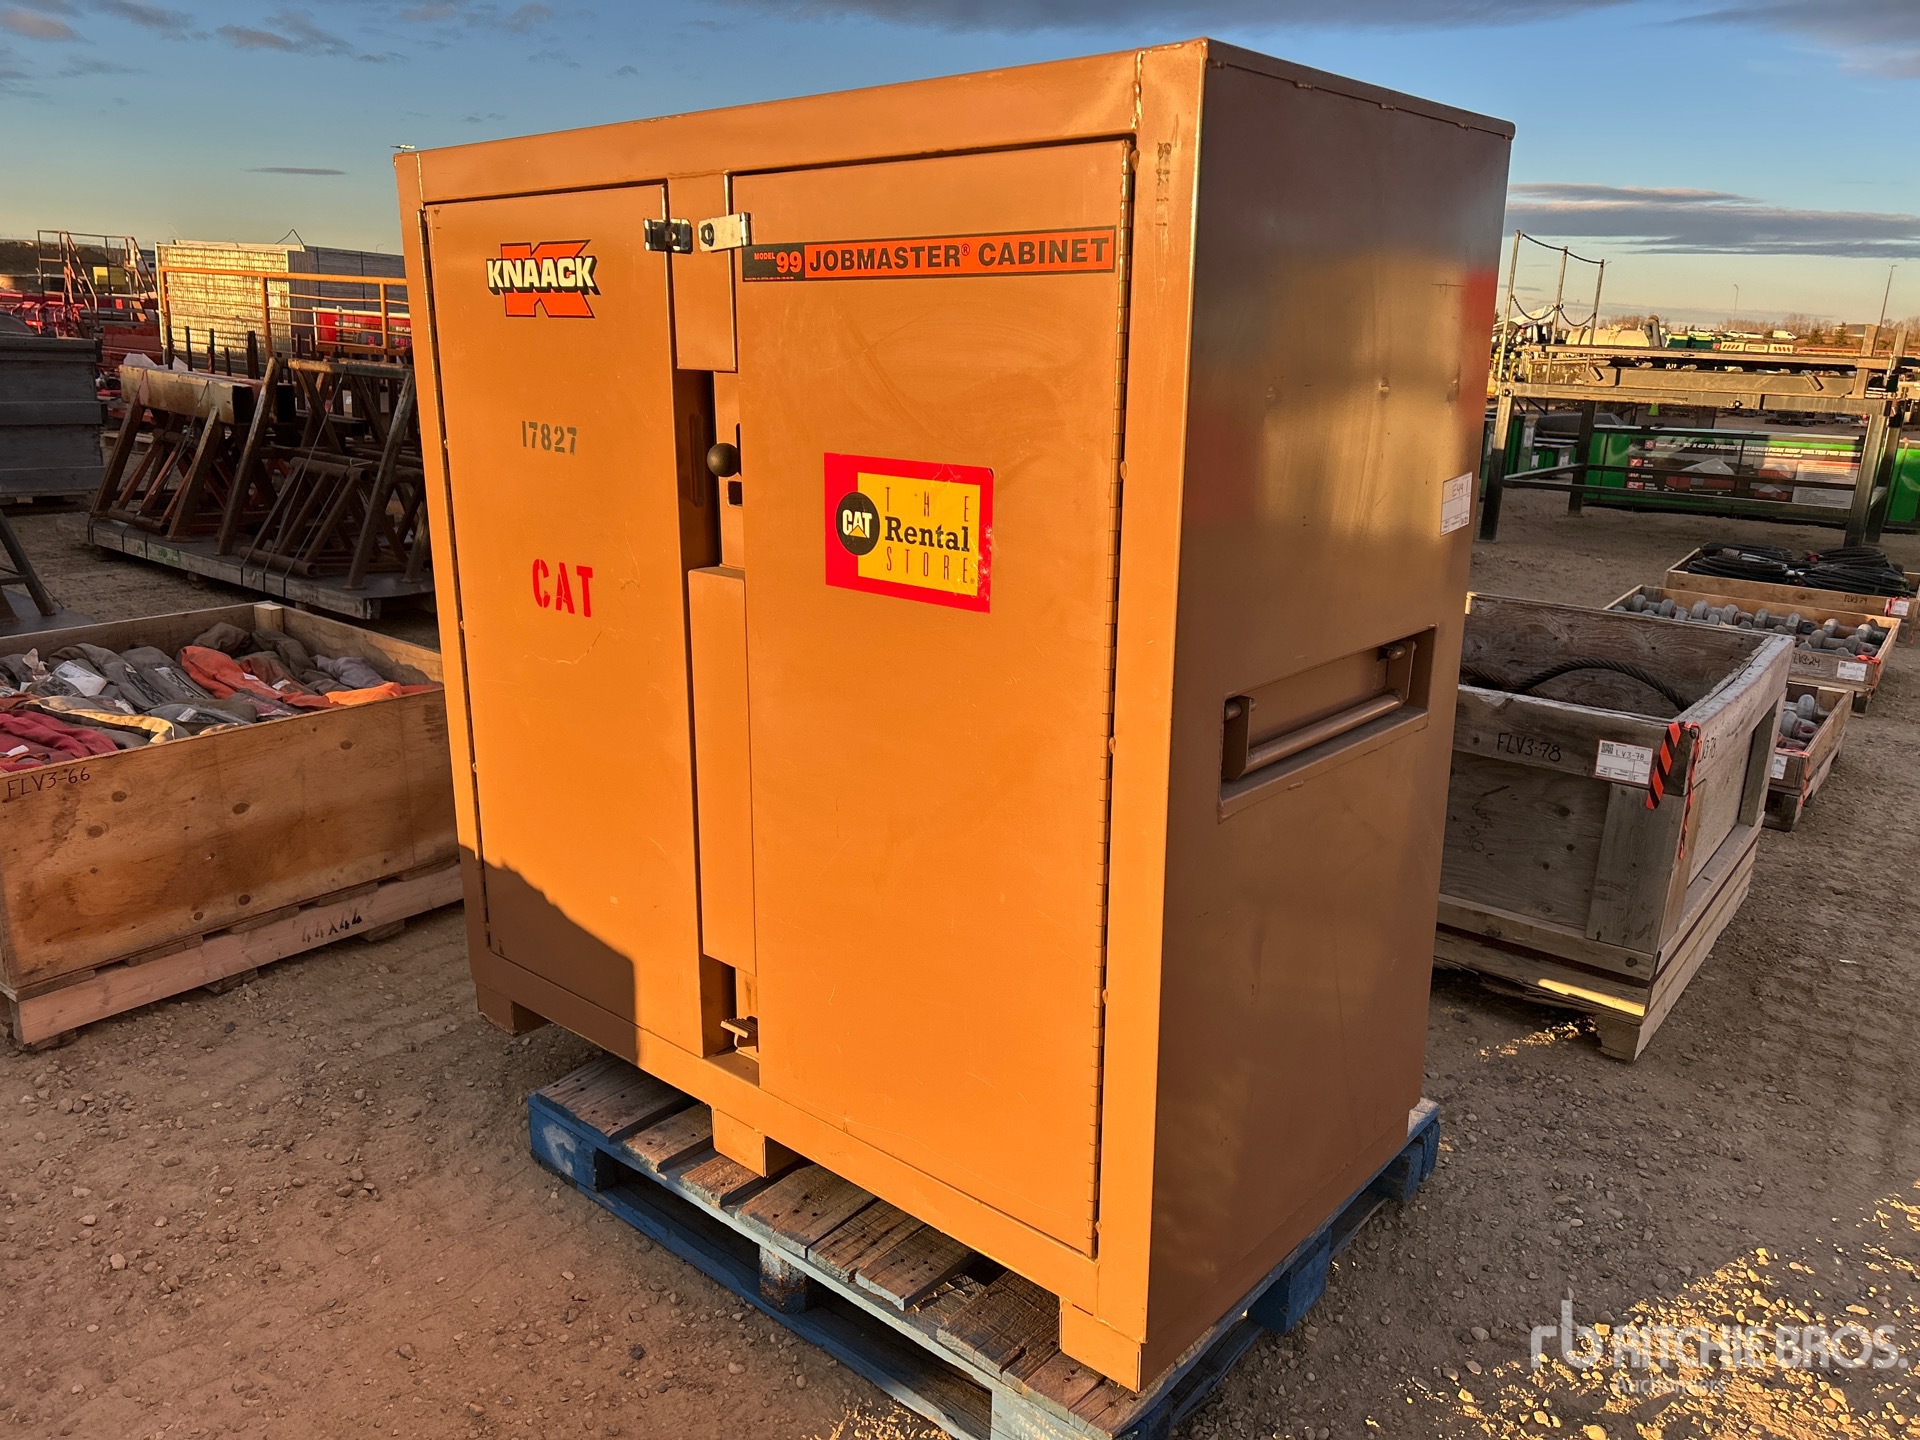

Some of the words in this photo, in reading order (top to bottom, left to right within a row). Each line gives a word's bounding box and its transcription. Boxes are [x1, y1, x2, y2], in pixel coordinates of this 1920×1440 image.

[753, 252, 776, 261] MODEL
[776, 250, 803, 274] 99
[978, 237, 1110, 267] CABINET
[486, 255, 601, 296] KNAACK
[521, 420, 577, 455] 17827
[885, 486, 970, 522] THE
[842, 509, 873, 539] CAT
[884, 515, 970, 552] Rental
[532, 558, 594, 618] CAT
[6, 766, 91, 799] FLV3-66
